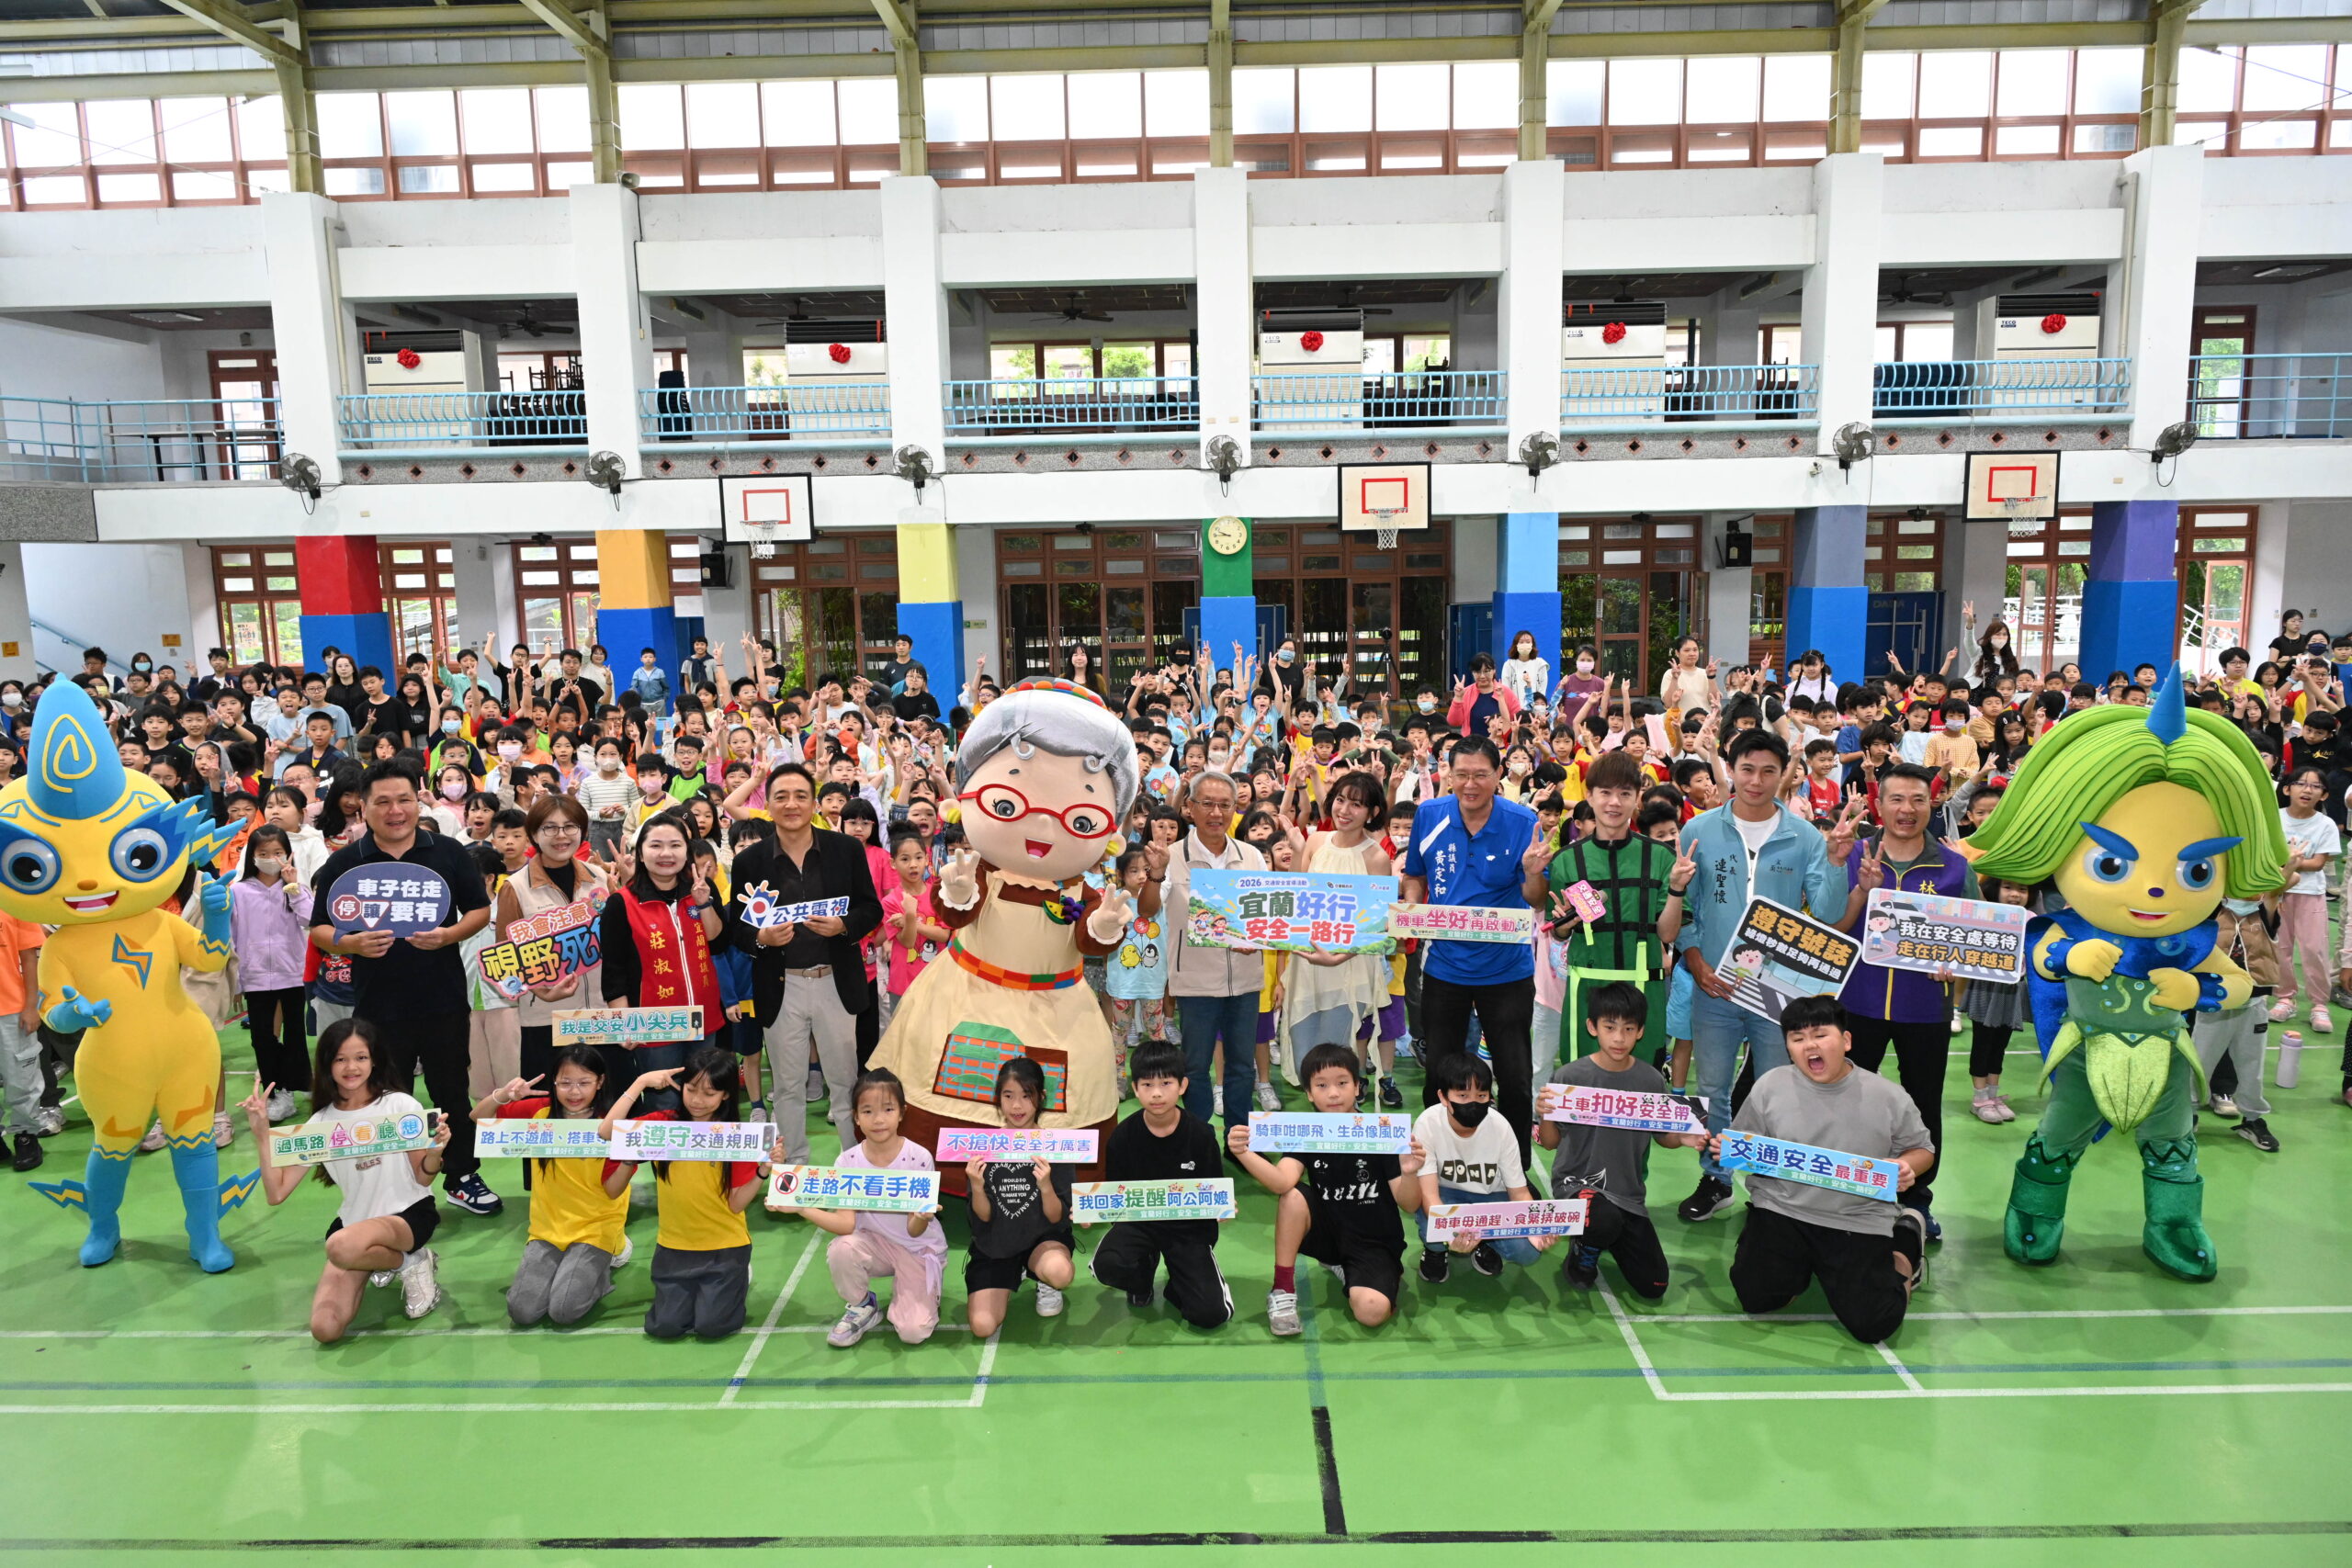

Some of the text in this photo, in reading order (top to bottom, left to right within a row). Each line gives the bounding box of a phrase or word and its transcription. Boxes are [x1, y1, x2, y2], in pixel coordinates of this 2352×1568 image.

[1448, 843, 1457, 874] 縣議員
[1240, 879, 1261, 887] 2026
[1434, 850, 1447, 897] 黃定和
[1713, 858, 1727, 904] 連聖懷
[1918, 880, 1937, 895] 林
[357, 879, 442, 897] 車子在走
[773, 897, 848, 925] 公共電視
[1238, 892, 1357, 922] 宜蘭好行
[1396, 908, 1516, 931] 機車坐好再啟動
[511, 904, 591, 942] 我會注意
[1246, 919, 1355, 945] 安全一路行
[1749, 905, 1852, 967] 遵守號誌
[1899, 920, 2018, 951] 我在安全處等待
[481, 916, 602, 985] 視野死
[1744, 927, 1842, 980] 綠燈秒數足夠再通過
[1897, 940, 2016, 971] 走在行人穿越道
[650, 931, 674, 999] 莊淑如
[560, 1010, 689, 1034] 我是交安小尖兵
[1557, 1092, 1691, 1121] 上車扣好安全帶
[626, 1124, 759, 1149] 我遵守交通規則
[946, 1134, 1091, 1151] 不搶快安全才厲害
[1255, 1123, 1406, 1139] 騎車咁哪飛、生命像風吹
[356, 1157, 382, 1171] RULES
[1731, 1138, 1889, 1188] 交通安全最重要
[802, 1174, 932, 1199] 走路不看手機
[1079, 1188, 1229, 1210] 我回家提醒阿公阿嬤
